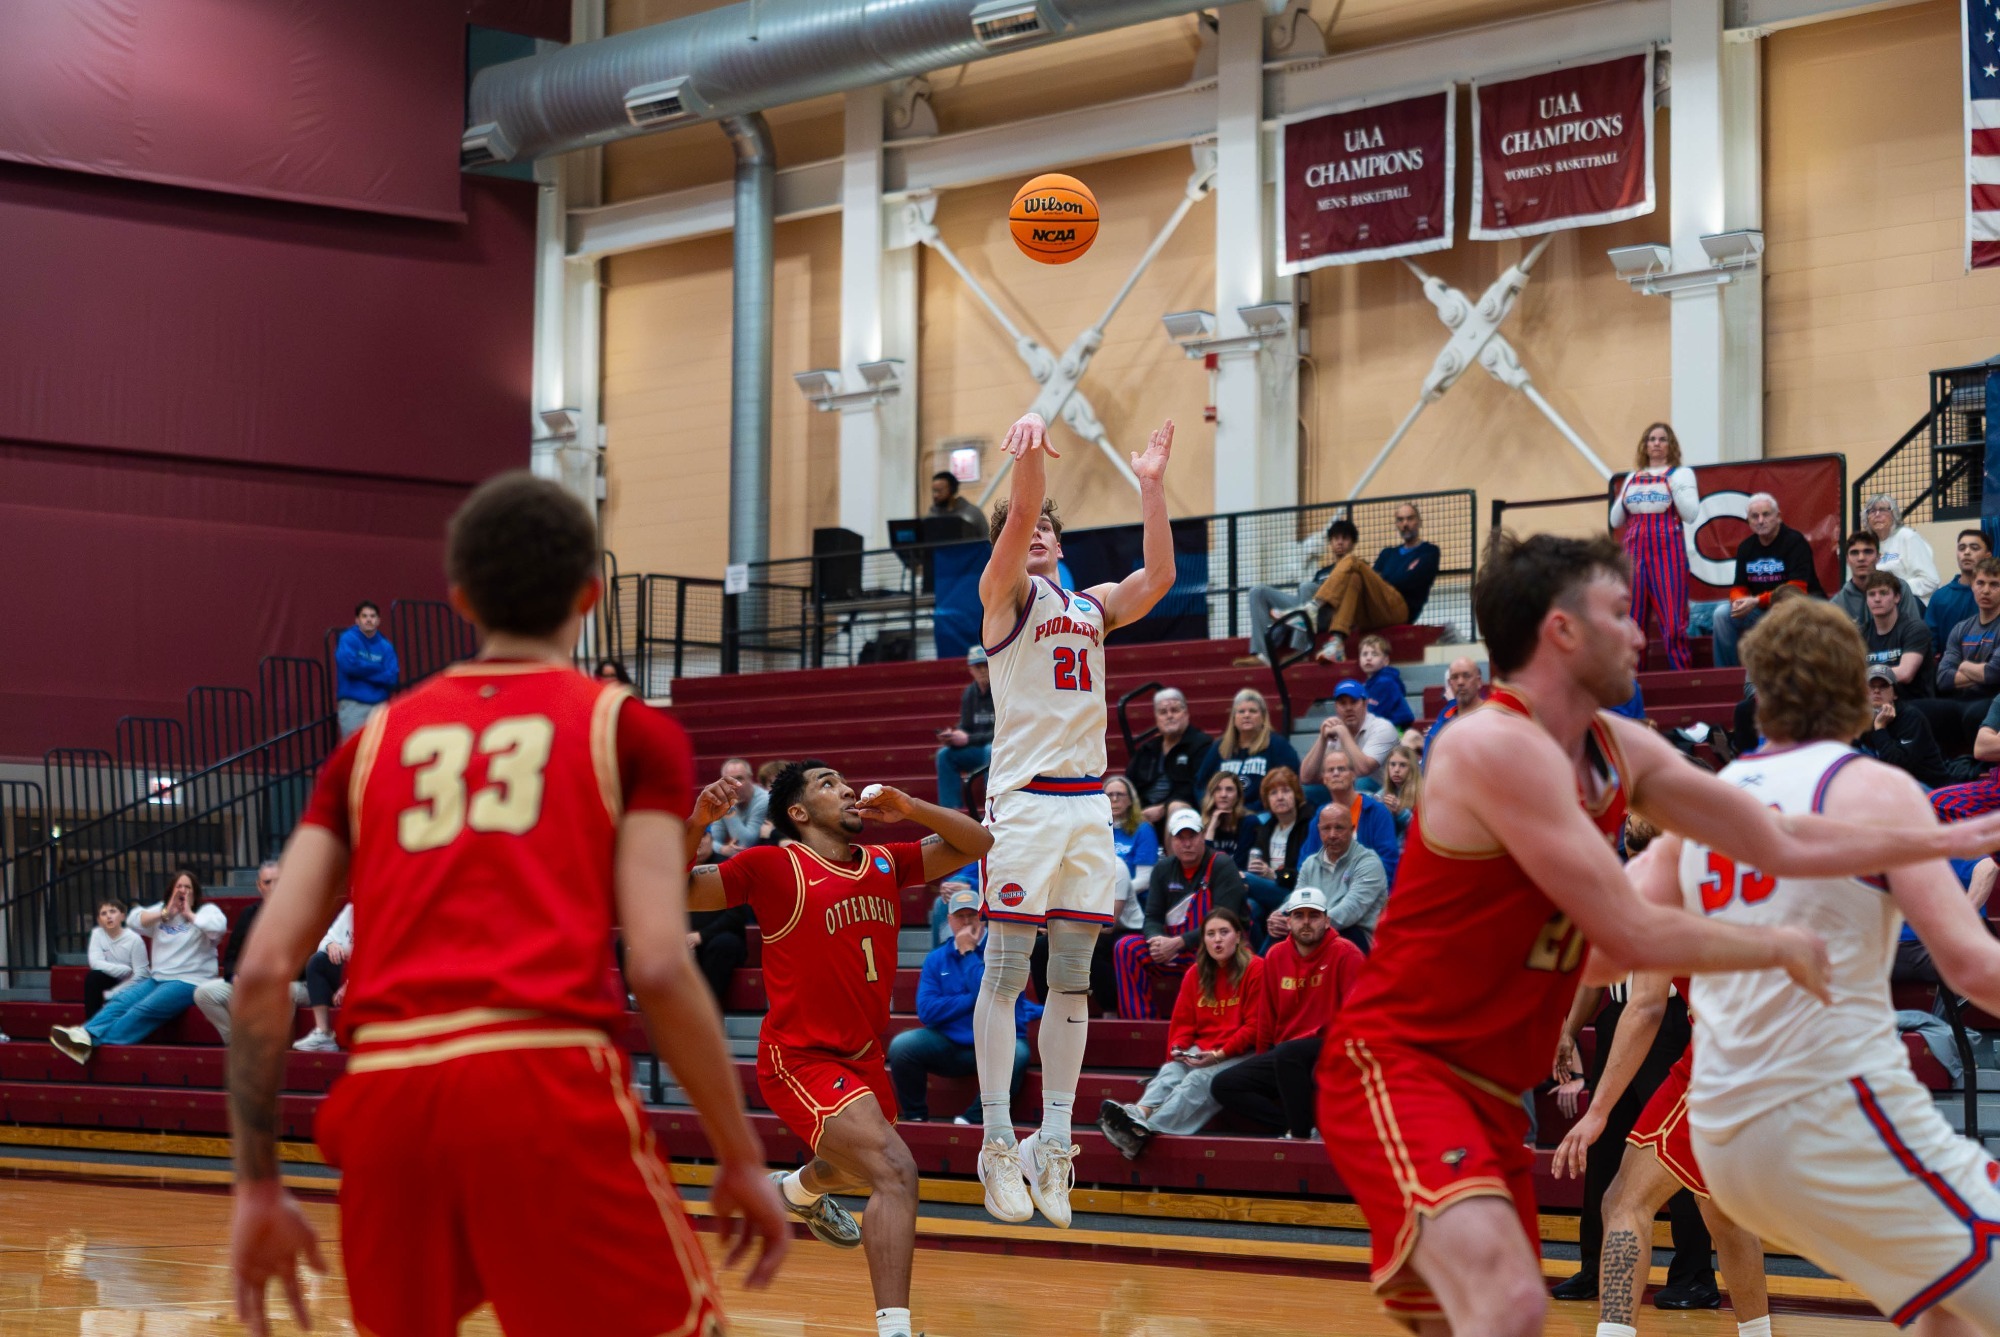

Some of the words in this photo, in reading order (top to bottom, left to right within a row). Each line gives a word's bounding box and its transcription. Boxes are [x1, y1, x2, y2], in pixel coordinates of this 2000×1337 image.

[1539, 91, 1583, 119] UAA
[1344, 126, 1385, 152] UAA
[1501, 114, 1623, 156] CHAMPIONS
[1305, 148, 1424, 188] CHAMPIONS
[1555, 152, 1620, 173] BASKETBALL
[1024, 197, 1083, 215] Wilson
[1350, 186, 1411, 207] BASKETBALL
[1032, 229, 1076, 242] NCAA
[1053, 646, 1093, 692] 21
[397, 714, 556, 853] 33
[825, 895, 896, 935] OTTERBEIN
[861, 936, 878, 982] 1
